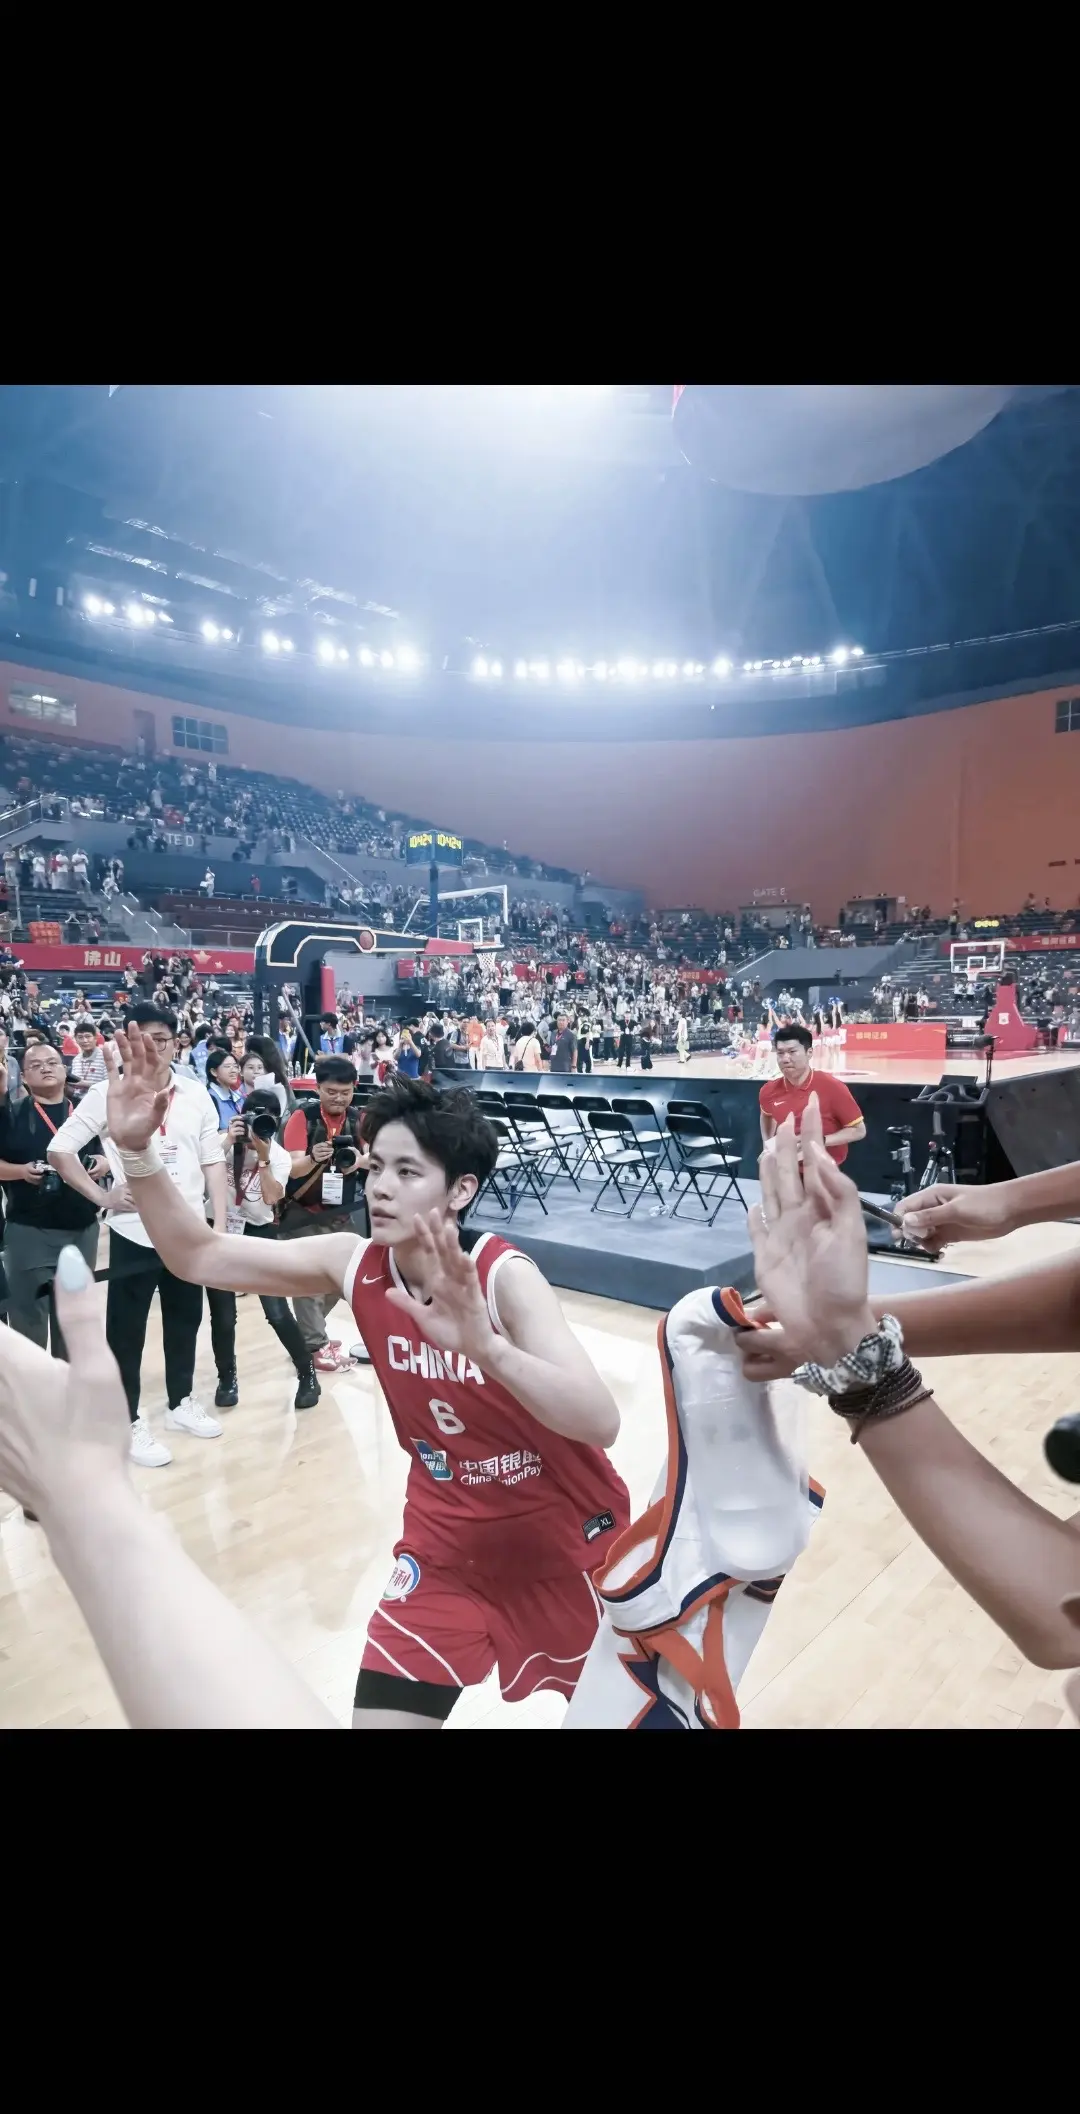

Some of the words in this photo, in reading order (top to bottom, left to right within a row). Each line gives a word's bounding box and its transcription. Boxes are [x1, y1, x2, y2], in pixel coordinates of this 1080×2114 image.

[84, 950, 121, 967] 佛山
[387, 1335, 485, 1385] CHINA
[428, 1398, 466, 1434] 6
[600, 1516, 611, 1527] XL
